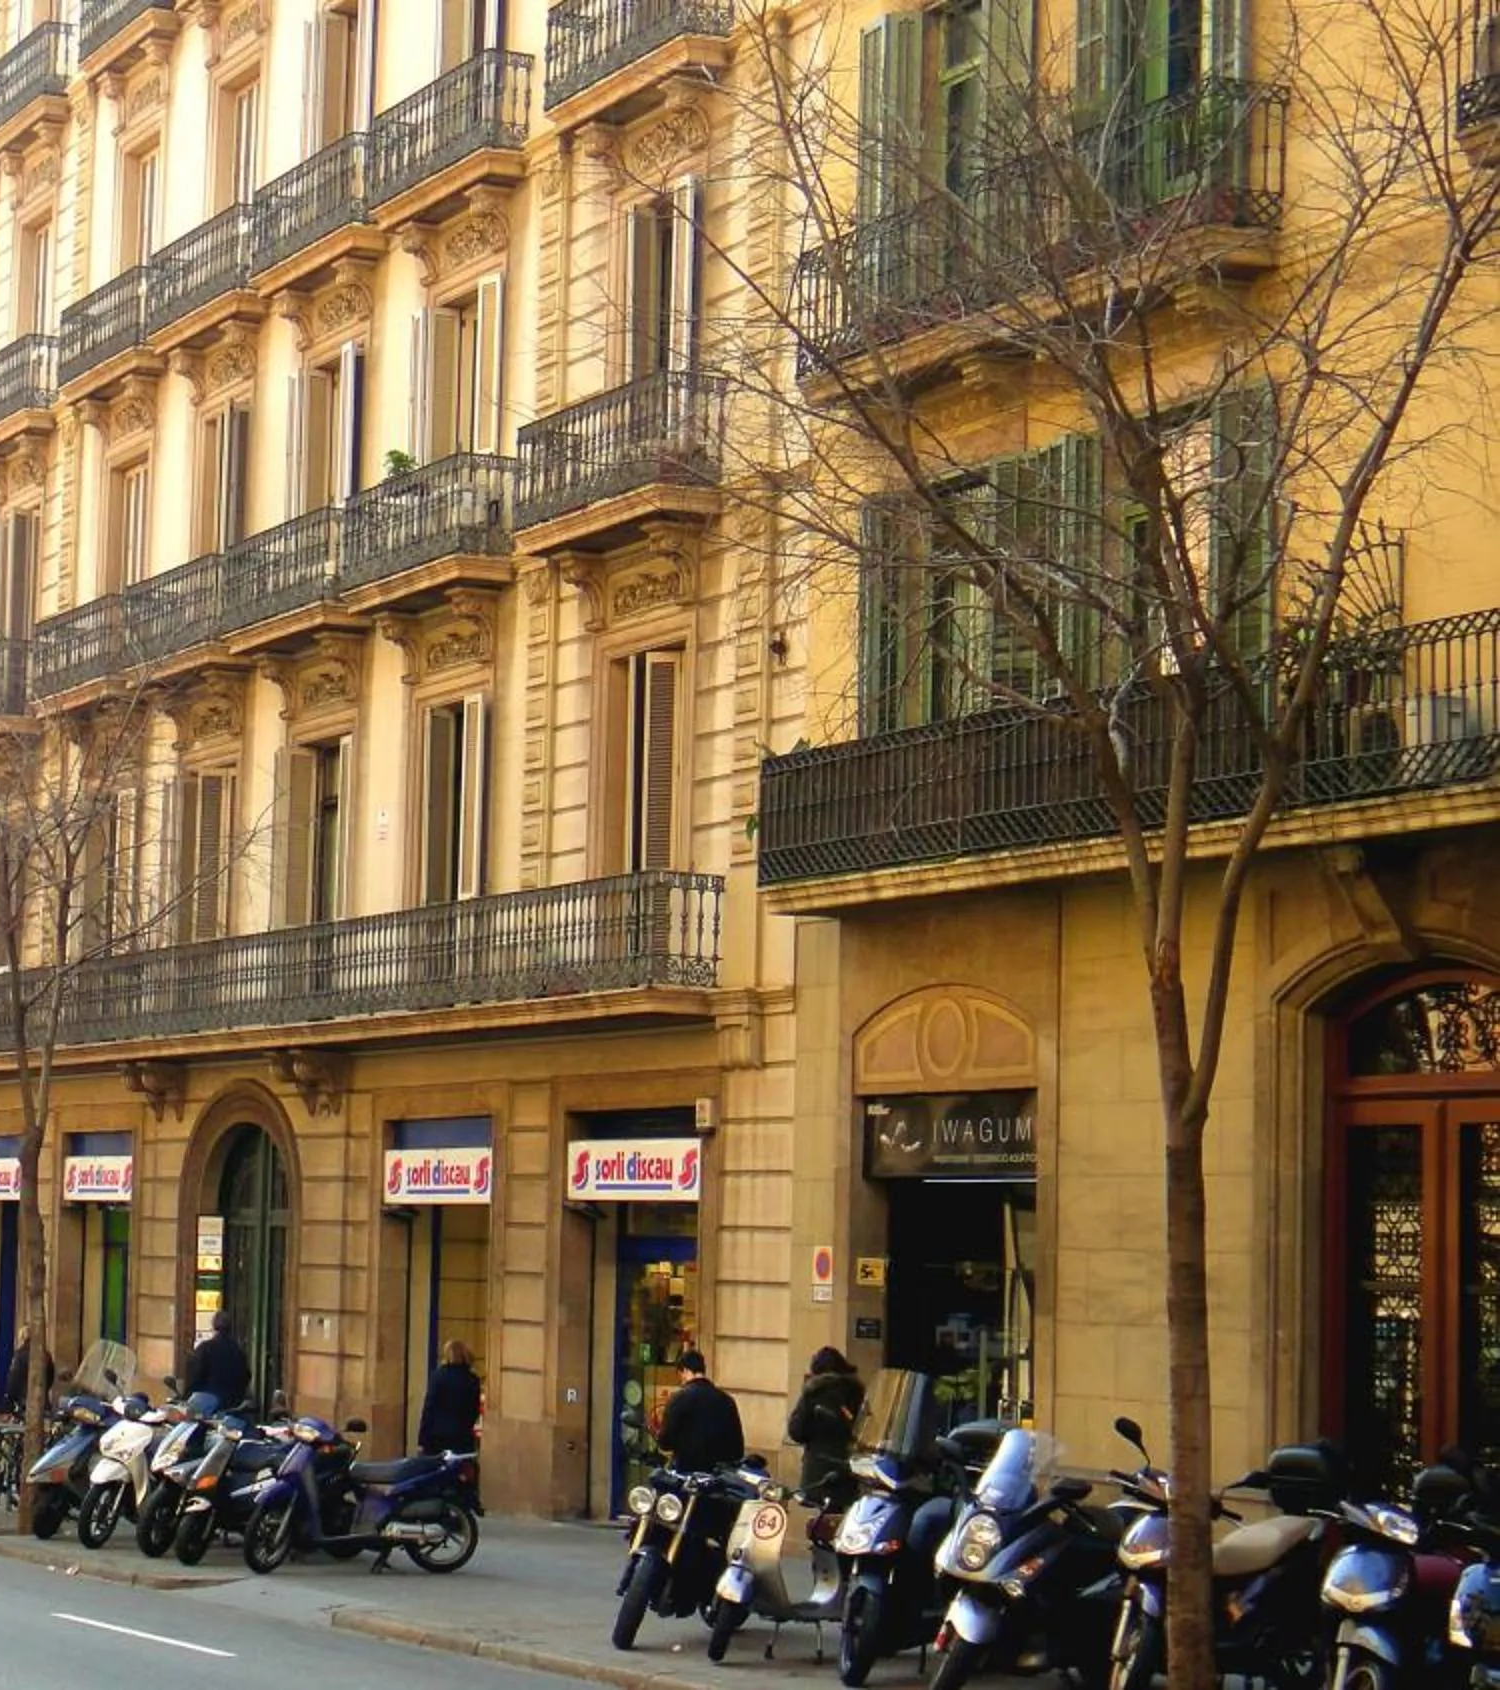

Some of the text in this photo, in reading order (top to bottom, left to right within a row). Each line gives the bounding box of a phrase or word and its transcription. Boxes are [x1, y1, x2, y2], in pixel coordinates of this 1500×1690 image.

[432, 1159, 470, 1186] discau
[595, 1151, 625, 1181] sorli
[627, 1151, 673, 1181] discau
[757, 1514, 777, 1530] 64
